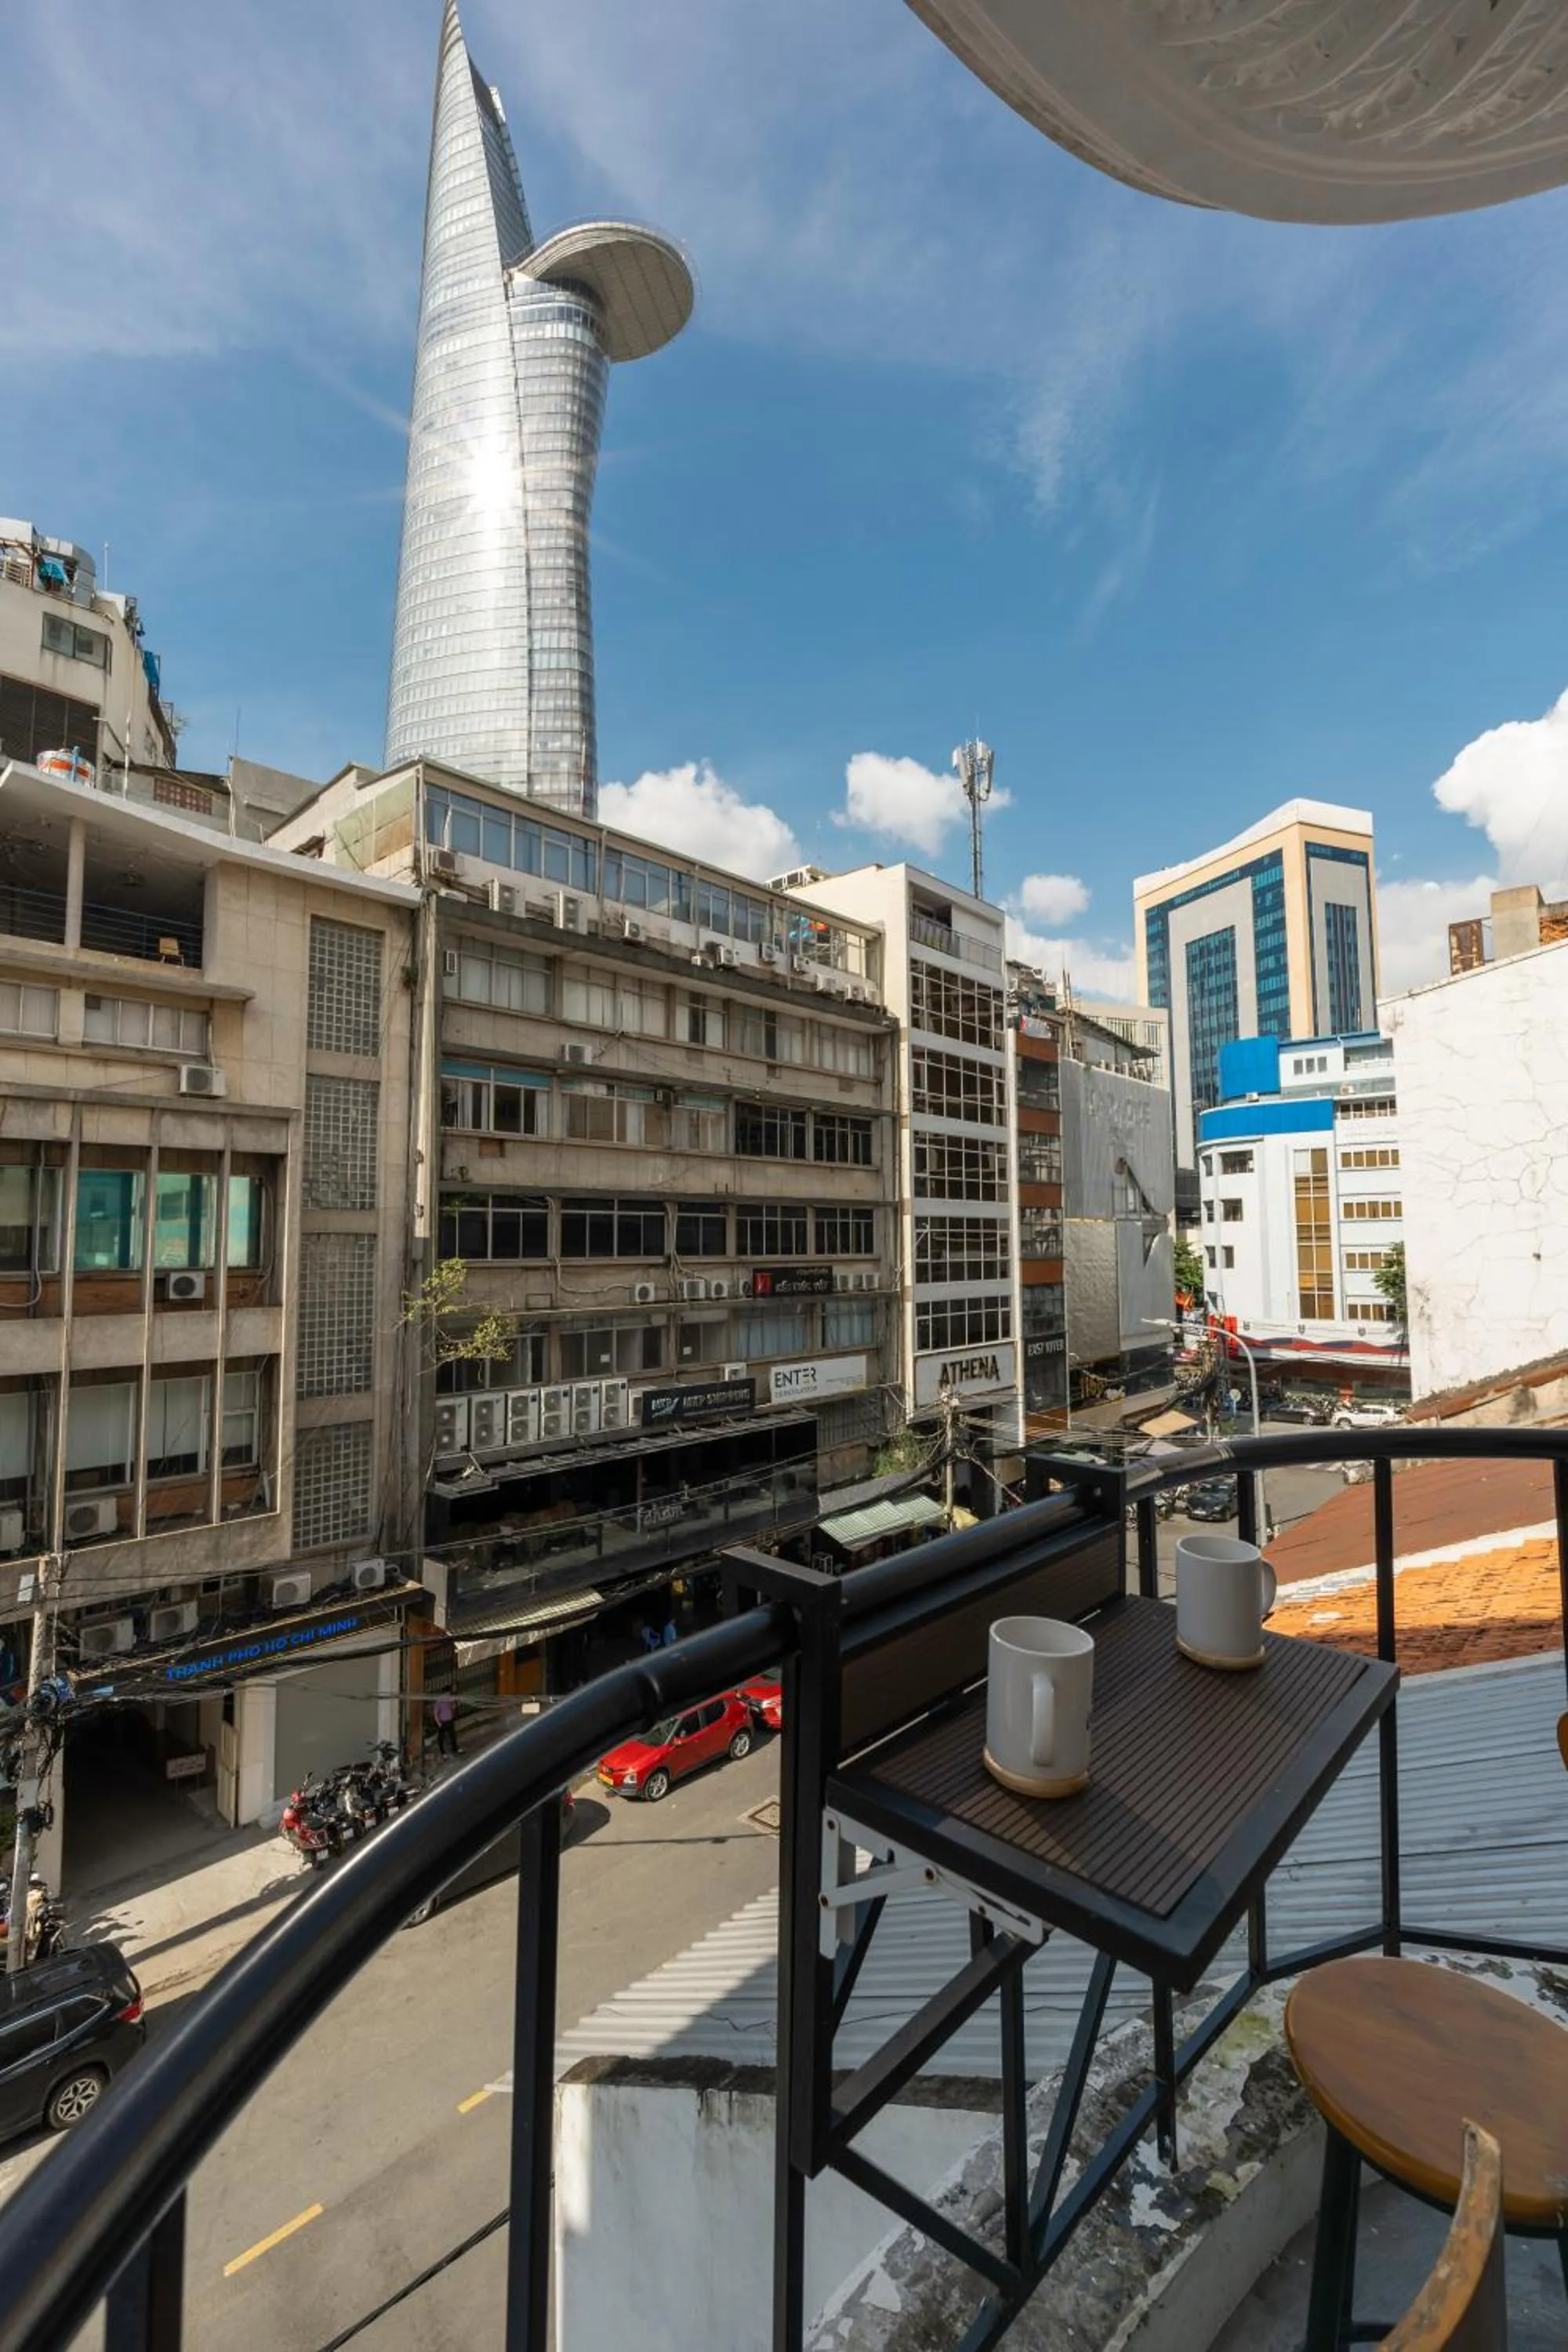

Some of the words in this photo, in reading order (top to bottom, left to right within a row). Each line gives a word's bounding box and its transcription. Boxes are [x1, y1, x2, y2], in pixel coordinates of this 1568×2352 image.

[775, 1367, 816, 1388] ENTER
[940, 1354, 1000, 1385] ATHENA
[291, 1629, 314, 1646] CHI
[319, 1617, 358, 1638] MINH
